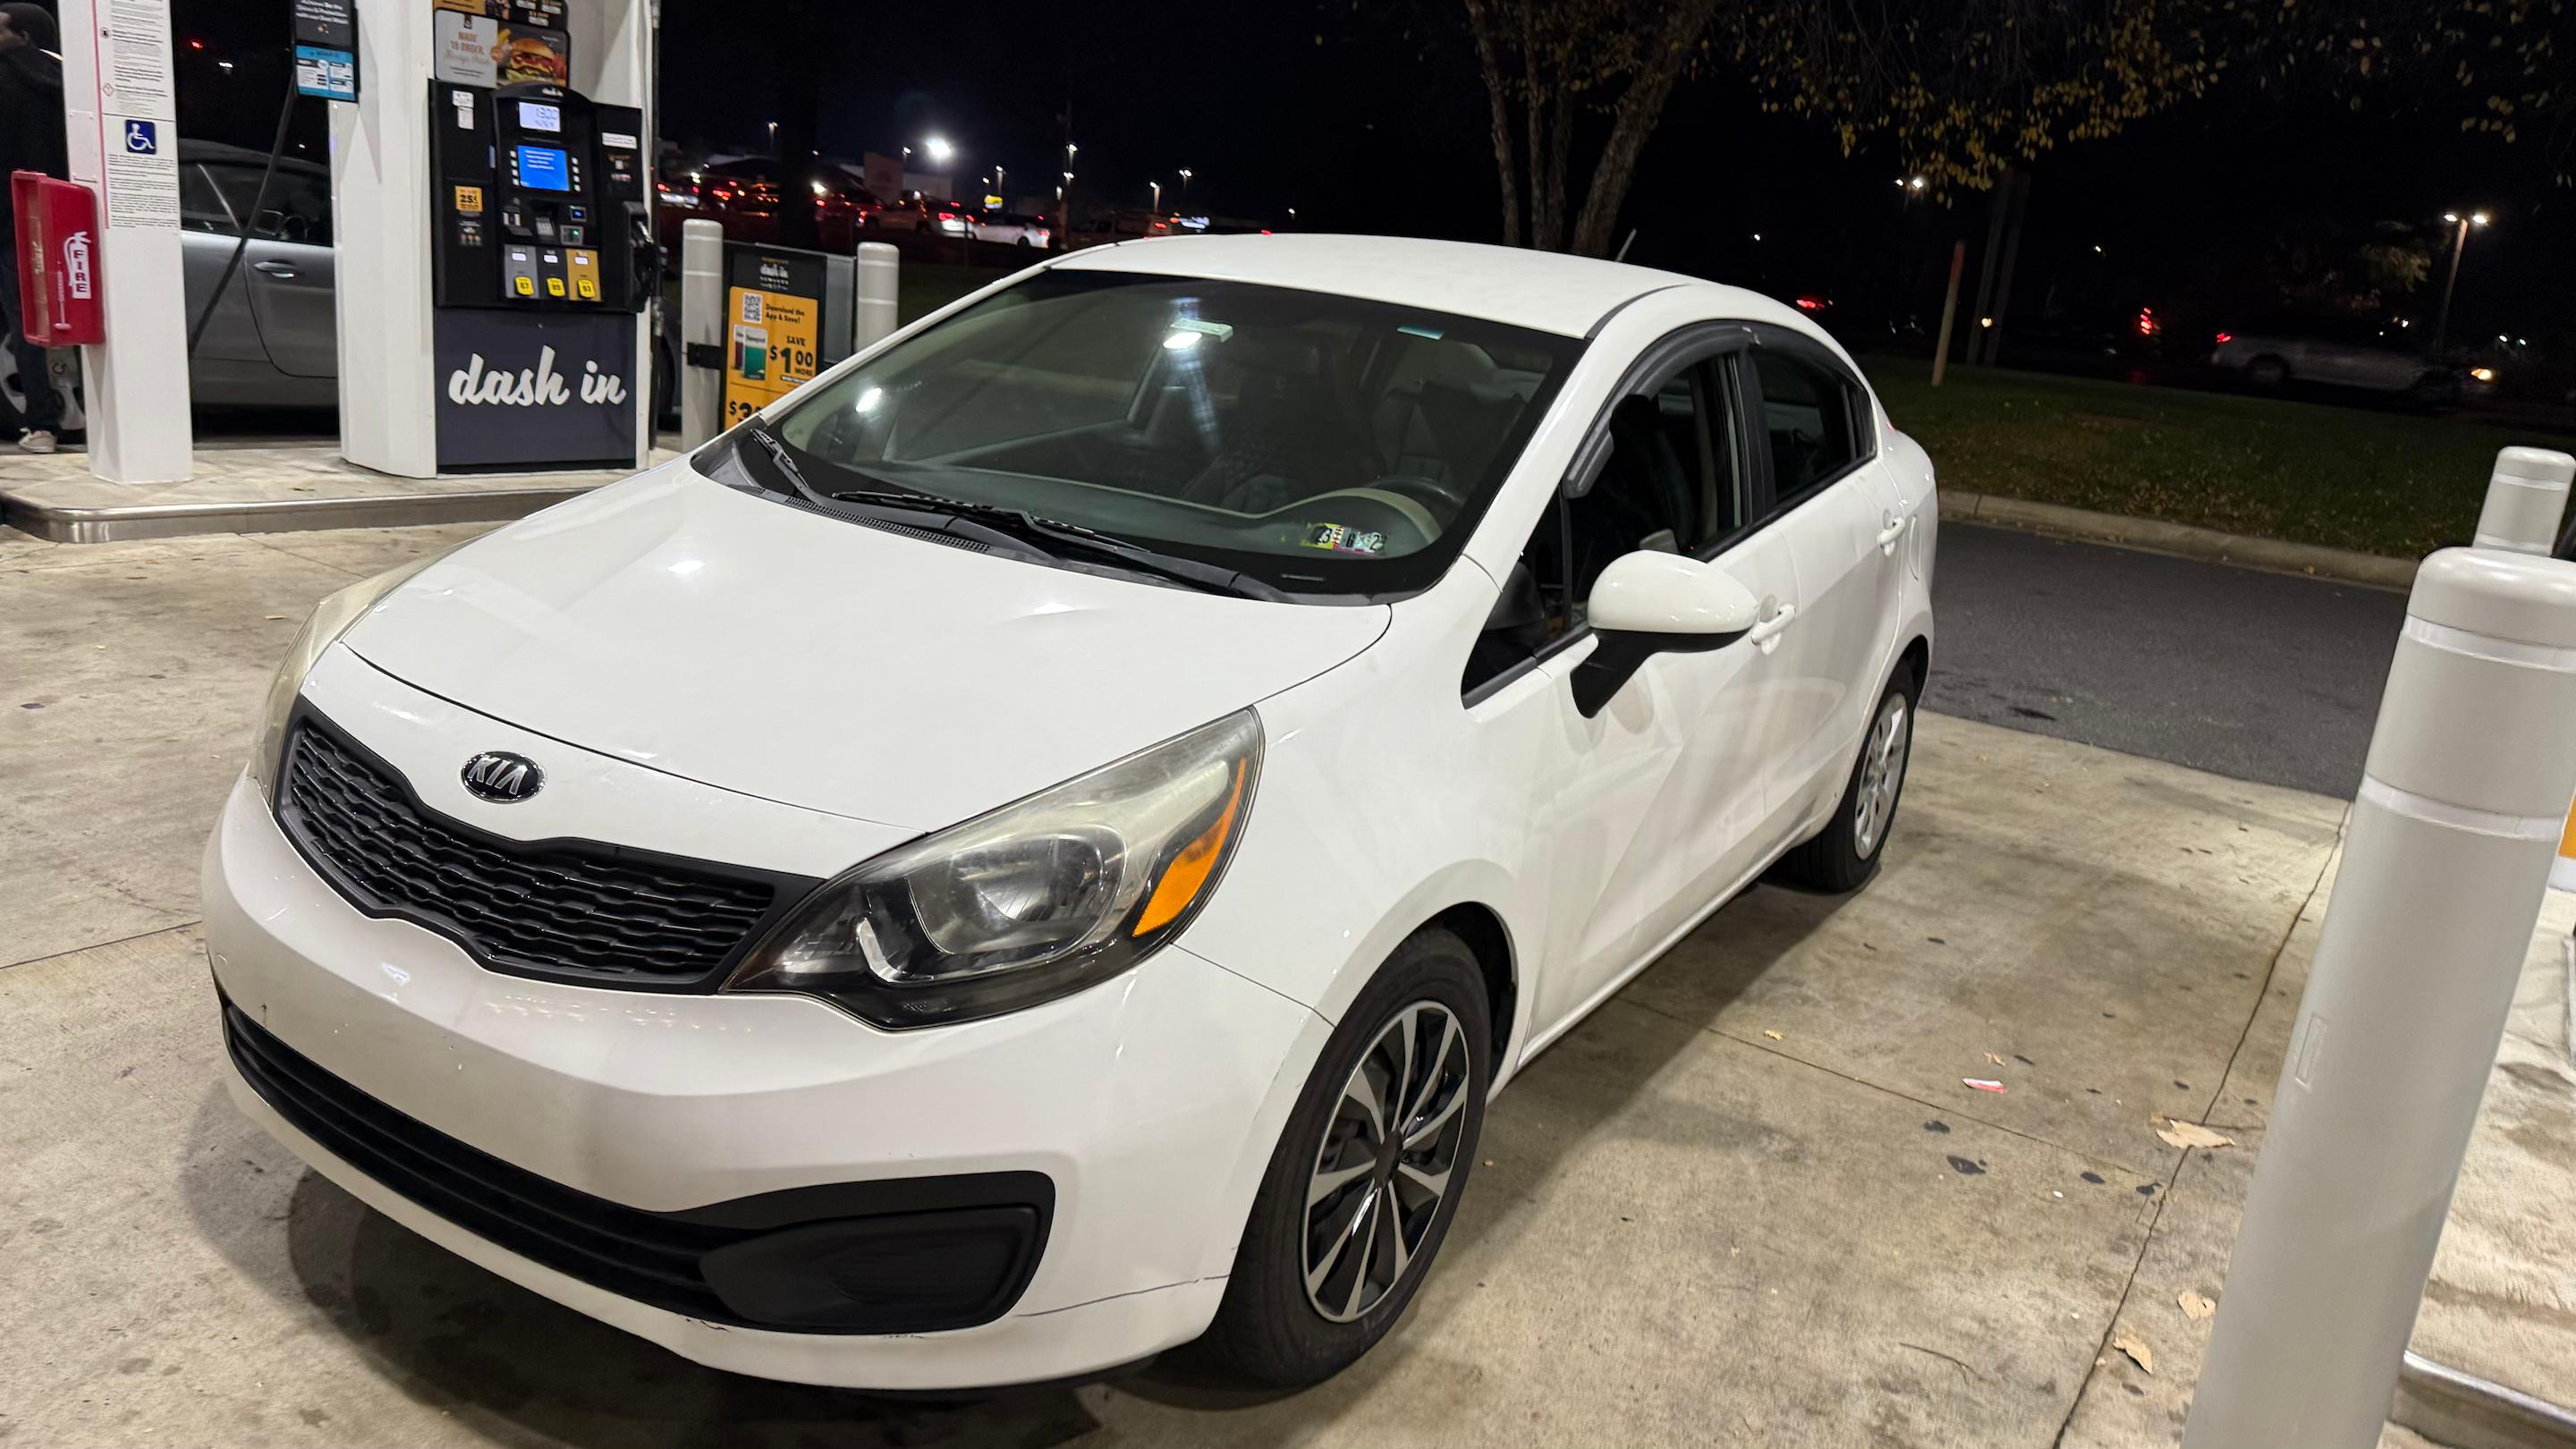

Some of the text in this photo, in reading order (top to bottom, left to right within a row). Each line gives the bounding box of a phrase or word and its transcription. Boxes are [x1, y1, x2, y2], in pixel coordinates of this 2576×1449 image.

[73, 250, 88, 292] FIRE
[766, 303, 794, 315] Download
[766, 312, 777, 321] App
[784, 314, 801, 323] Save!
[786, 335, 806, 347] SAVE
[448, 343, 627, 407] dash in
[466, 756, 529, 796] KIA
